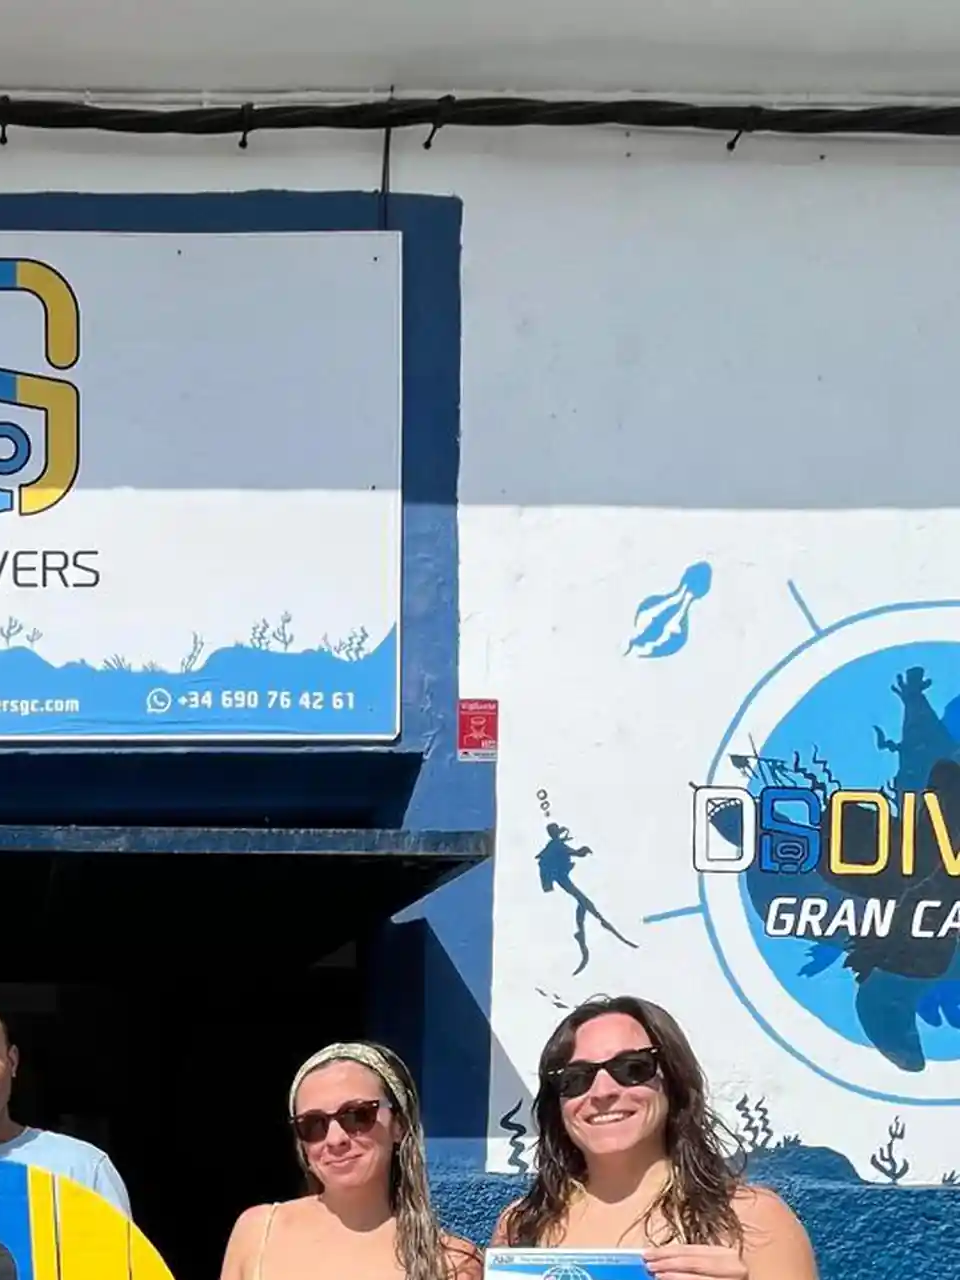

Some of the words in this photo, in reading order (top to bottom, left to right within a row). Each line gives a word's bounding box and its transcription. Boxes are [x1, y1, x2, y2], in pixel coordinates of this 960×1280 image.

[177, 690, 213, 709] +34
[221, 690, 259, 709] 690
[267, 690, 292, 709] 76
[299, 691, 324, 710] 42
[331, 692, 356, 710] 61
[764, 896, 898, 938] GRAN
